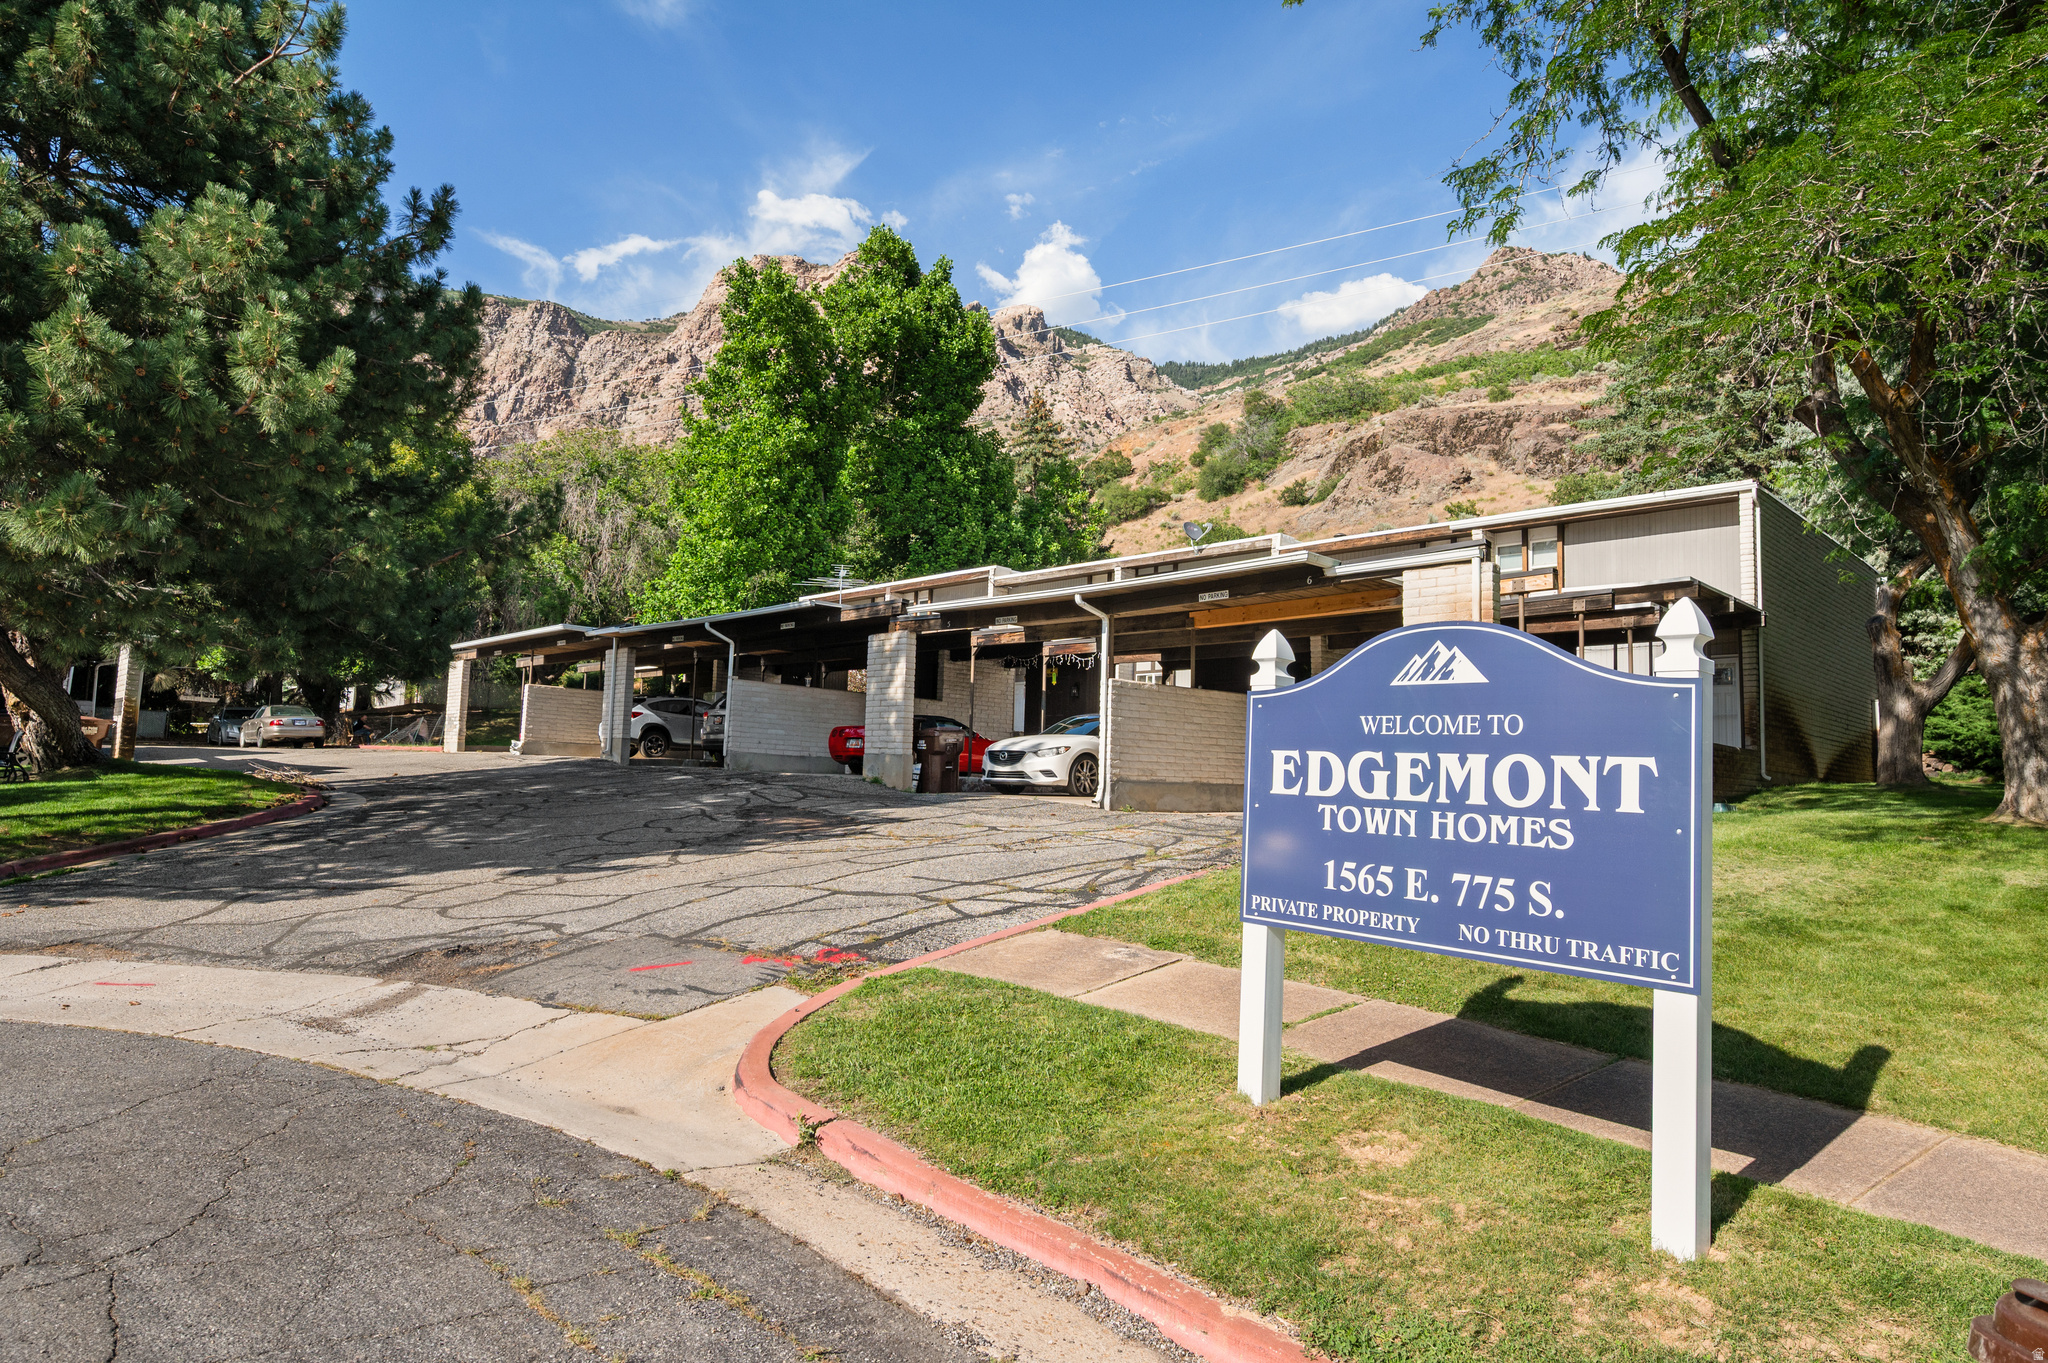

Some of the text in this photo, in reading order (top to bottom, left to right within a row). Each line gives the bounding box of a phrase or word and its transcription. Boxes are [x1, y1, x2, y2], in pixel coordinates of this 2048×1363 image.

[1208, 591, 1228, 600] PARKING
[1306, 576, 1313, 585] 6
[1359, 714, 1524, 736] WELCOME TO
[1269, 749, 1659, 814] EDGEMONT
[1317, 803, 1575, 850] TOWN HOMES
[1323, 859, 1565, 919] 1565 E. 775 S.
[1251, 894, 1421, 934] PRIVATE PROPERTY
[1458, 923, 1680, 972] NO THRU TRAFFIC
